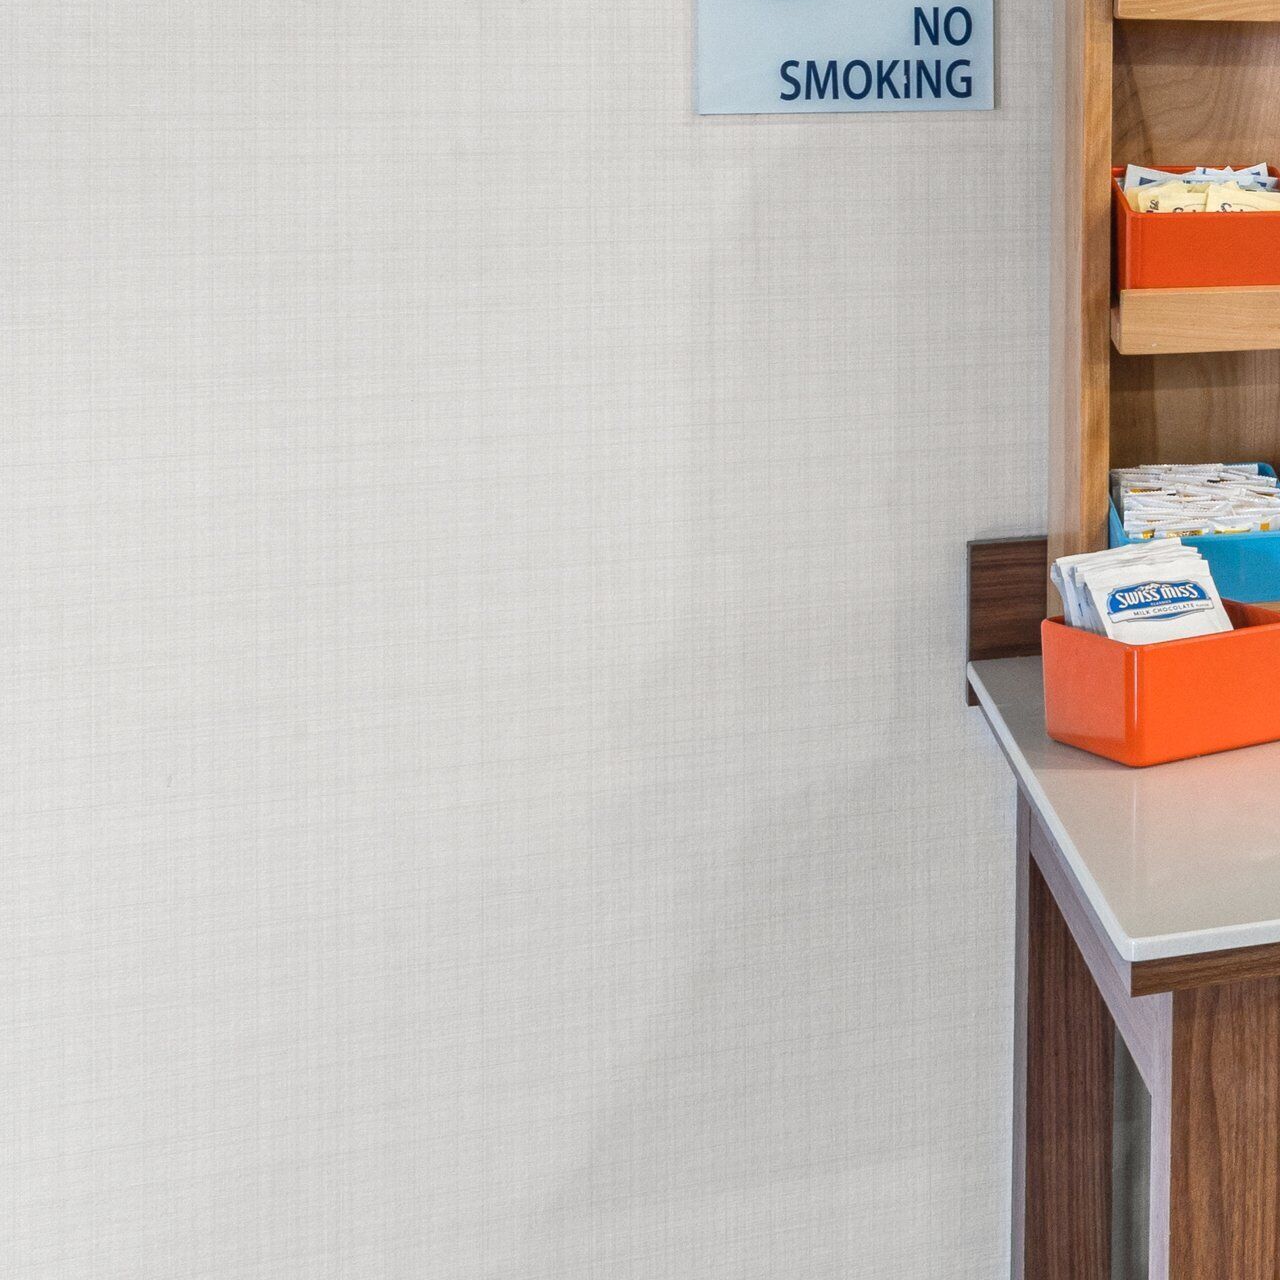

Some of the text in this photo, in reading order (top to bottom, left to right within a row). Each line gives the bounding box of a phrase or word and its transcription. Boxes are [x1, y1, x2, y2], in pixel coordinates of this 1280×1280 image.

[914, 6, 972, 46] NO
[780, 59, 973, 101] SMOKING
[1153, 604, 1194, 613] CHOCOLATE
